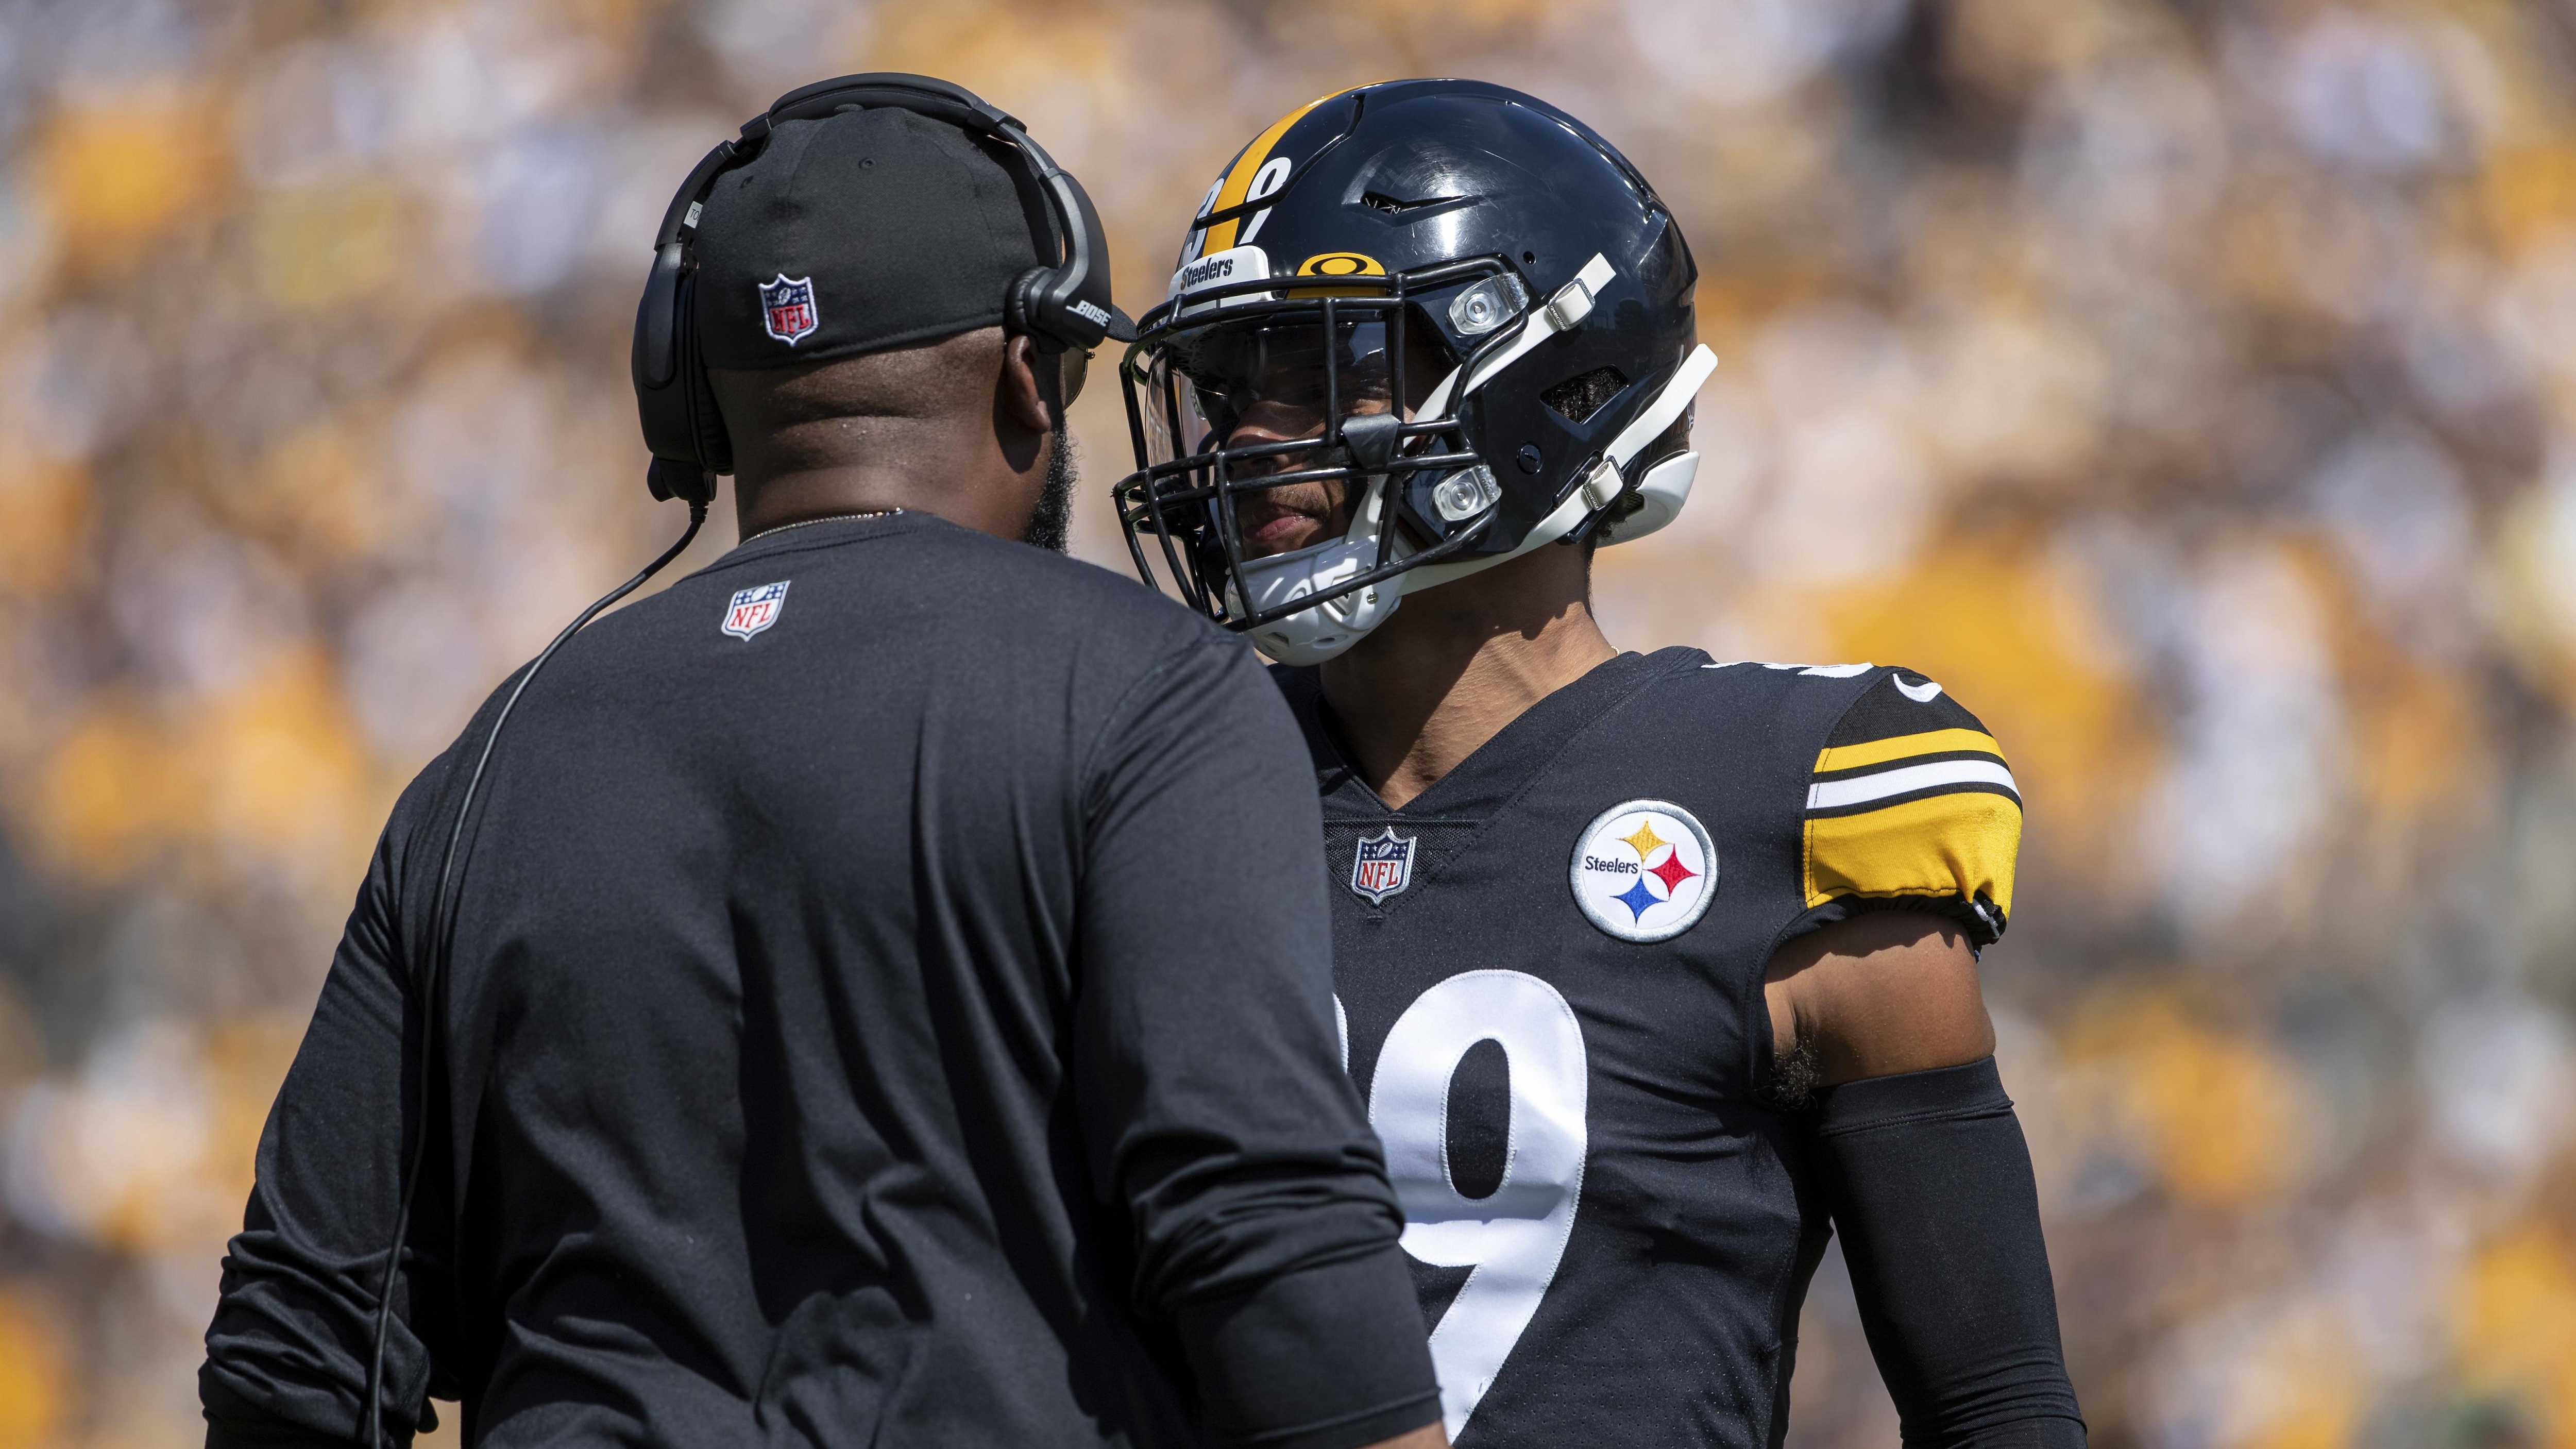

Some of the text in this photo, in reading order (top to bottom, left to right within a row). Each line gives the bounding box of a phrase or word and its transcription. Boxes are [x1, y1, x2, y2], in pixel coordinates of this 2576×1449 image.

[690, 208, 701, 221] TO
[1180, 257, 1233, 291] Steelers
[769, 304, 811, 333] NFL
[1065, 300, 1112, 327] BOSE
[730, 603, 771, 629] NFL
[1360, 862, 1398, 889] NFL
[1585, 855, 1638, 874] Steelers
[1333, 969, 1588, 1446] 9
